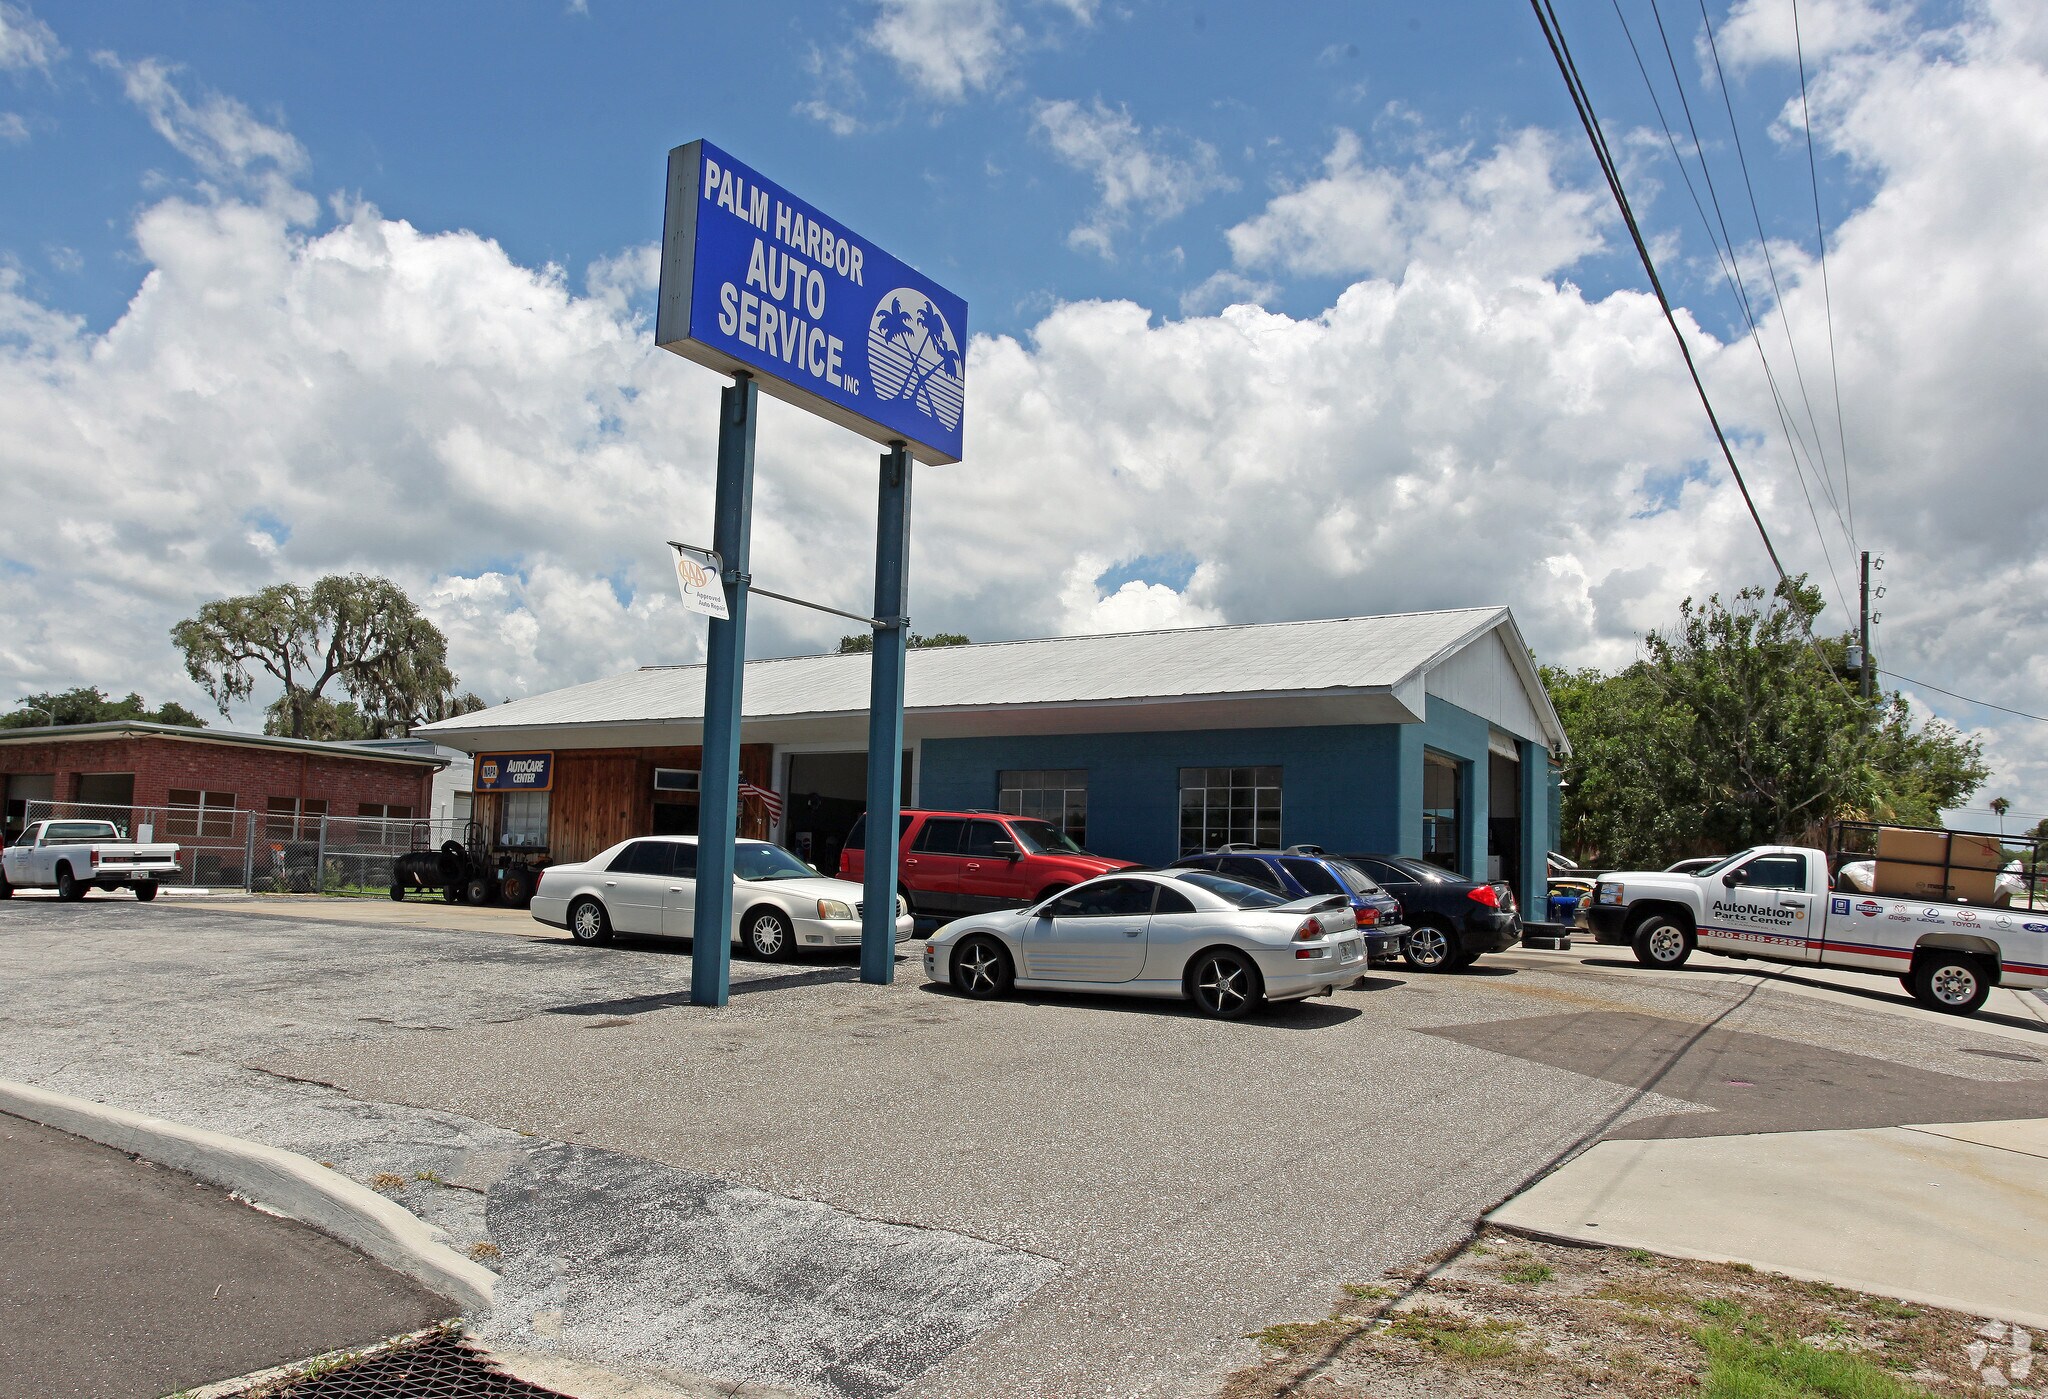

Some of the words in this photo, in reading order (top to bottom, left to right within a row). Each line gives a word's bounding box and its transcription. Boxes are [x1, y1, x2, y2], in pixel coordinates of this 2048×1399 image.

[704, 158, 769, 232] PALM
[775, 201, 864, 287] HARBOR
[745, 237, 826, 320] AUTO
[718, 281, 844, 388] SERVICE
[844, 373, 860, 396] INC
[680, 560, 707, 588] AAA
[696, 591, 721, 603] Approved
[698, 600, 711, 608] Auto
[711, 602, 726, 611] Repair
[483, 766, 497, 778] NAPA
[512, 773, 536, 783] CENTER
[1712, 900, 1795, 919] AutoNation
[1856, 904, 1883, 913] NISSAN
[1714, 911, 1747, 921] Parts
[1750, 915, 1792, 926] Center
[1888, 914, 1912, 923] Dodge
[1916, 917, 1945, 925] LEXUS
[1951, 920, 1982, 929] TOYOTA
[2027, 923, 2047, 932] Ford
[1707, 930, 1807, 948] 800-888-2292
